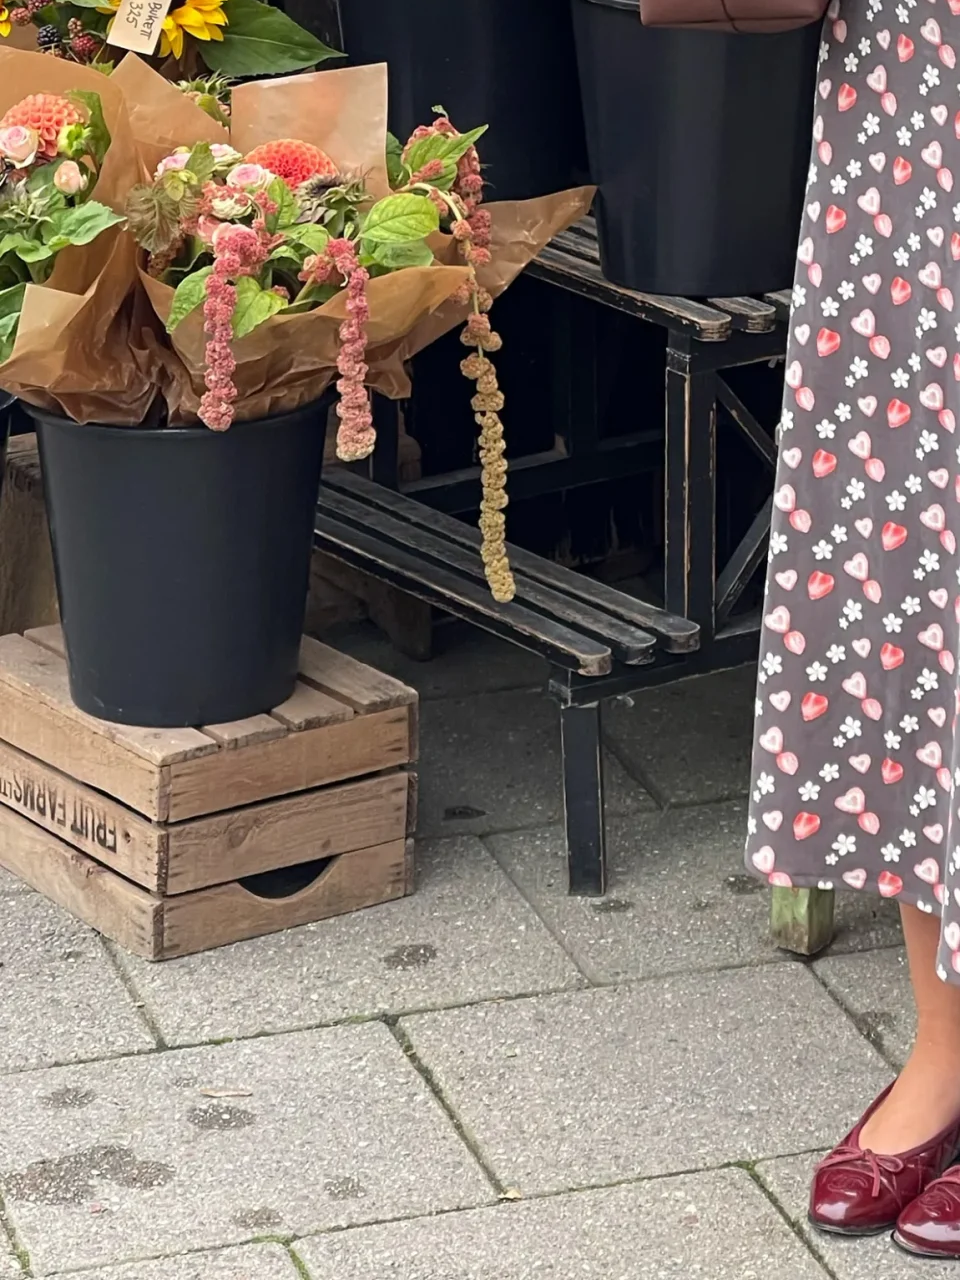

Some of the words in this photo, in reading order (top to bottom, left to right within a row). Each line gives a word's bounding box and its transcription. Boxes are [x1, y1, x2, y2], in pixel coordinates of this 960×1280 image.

[126, 1, 144, 29] 325
[0, 777, 12, 800] LT
[13, 770, 66, 827] FARMS
[70, 795, 117, 854] FRUIT
